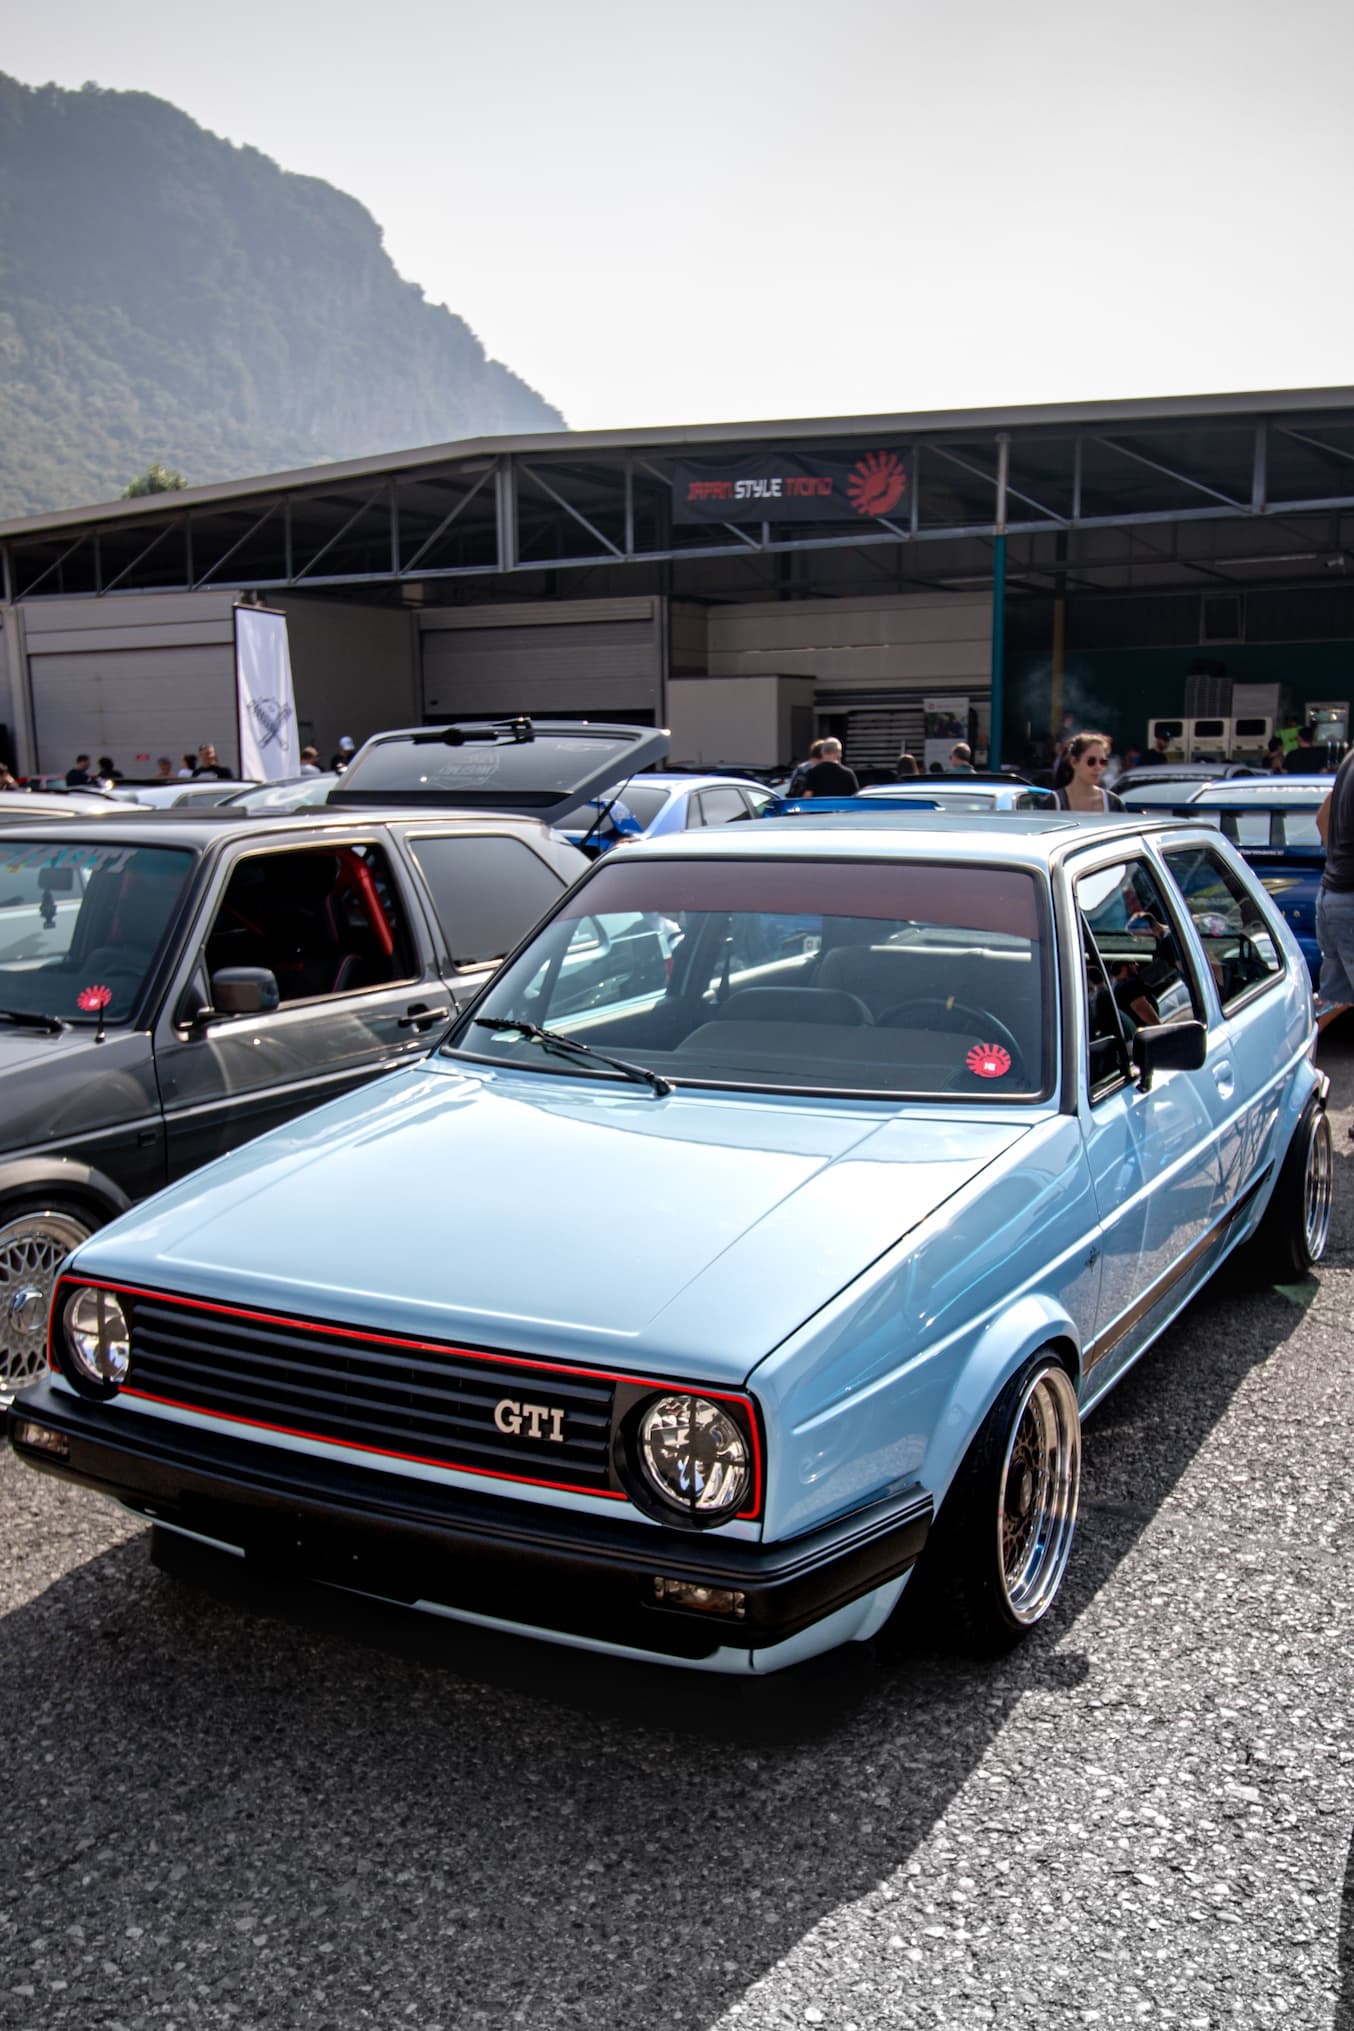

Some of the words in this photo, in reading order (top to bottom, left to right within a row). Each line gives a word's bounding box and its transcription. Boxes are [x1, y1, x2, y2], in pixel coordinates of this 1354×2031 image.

[688, 481, 732, 500] JAPAN
[734, 478, 782, 499] STYLE
[784, 477, 833, 497] TICINO
[494, 1398, 565, 1442] GTI
